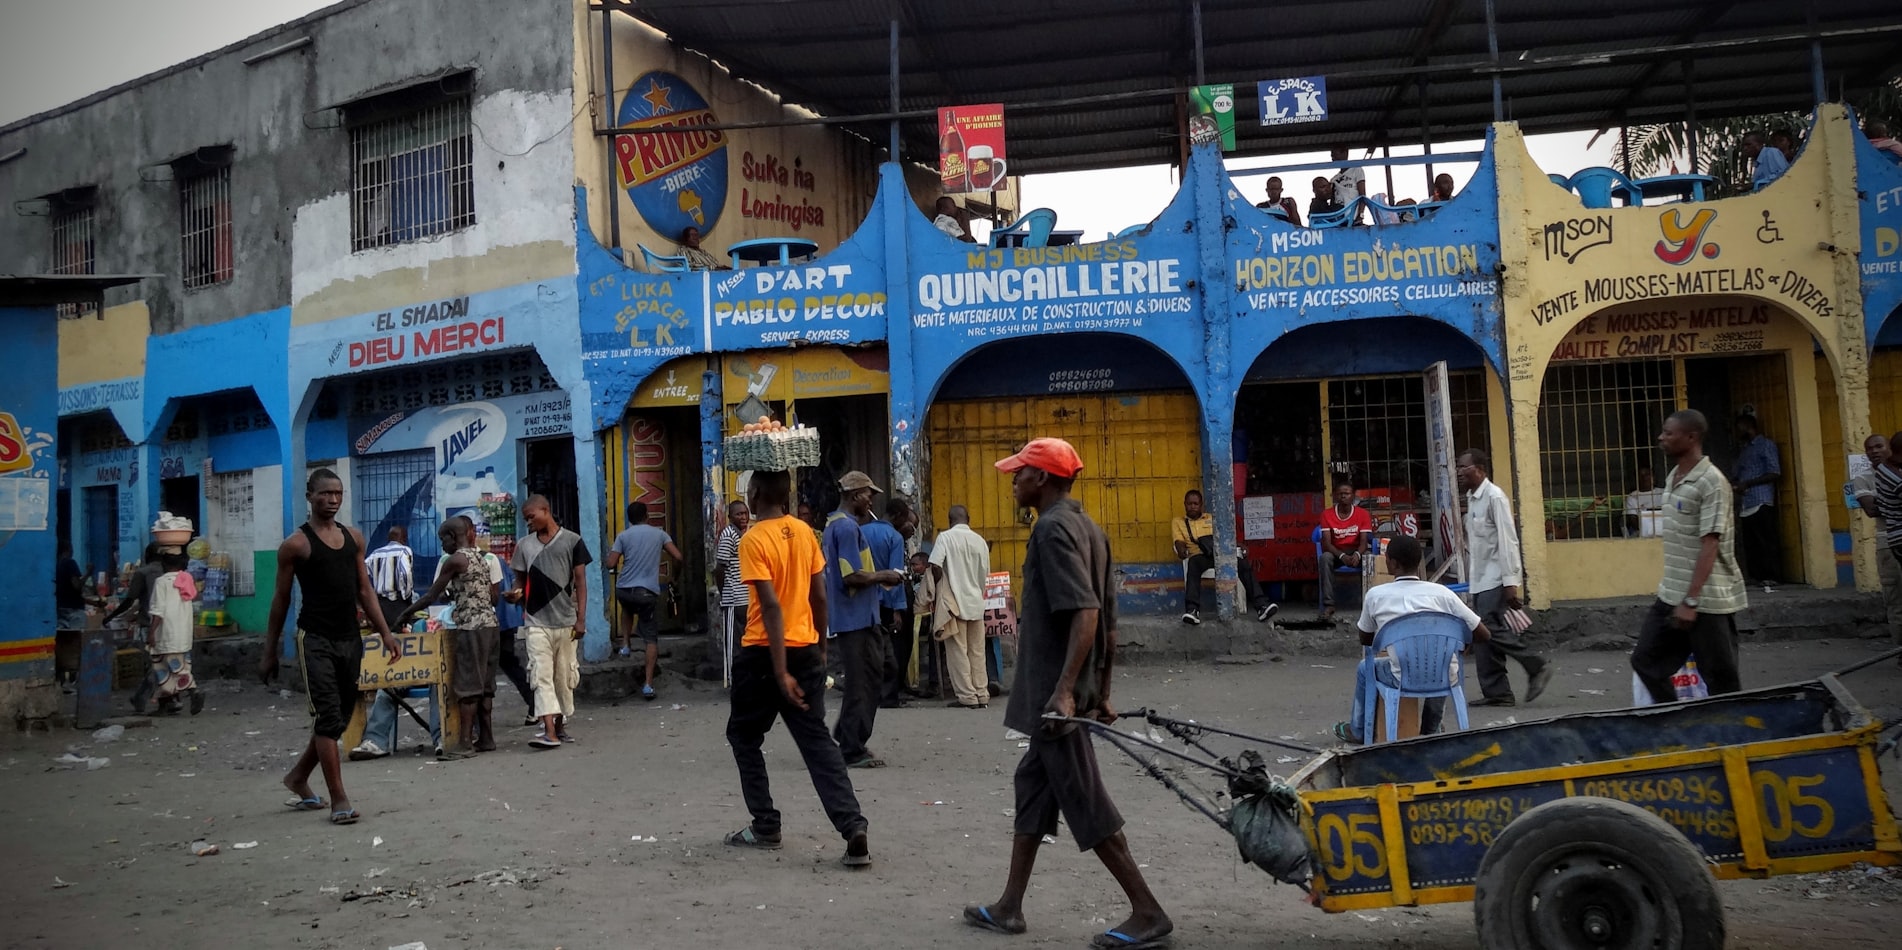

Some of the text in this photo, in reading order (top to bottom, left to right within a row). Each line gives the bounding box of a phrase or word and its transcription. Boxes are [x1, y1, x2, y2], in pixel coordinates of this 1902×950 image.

[1268, 78, 1315, 95] ESPACE
[965, 121, 1002, 130] D'HOMMES
[973, 114, 1002, 122] AFFAIRE
[615, 112, 723, 185] PRIMUS
[741, 187, 825, 231] Loningisa
[1014, 240, 1139, 267] BUSINESS
[1272, 230, 1324, 254] MSON
[756, 265, 852, 294] D'ART
[1236, 244, 1479, 291] HORIZON EDUCATION
[1861, 261, 1897, 275] VENTE
[621, 280, 674, 301] LUKA
[919, 258, 1182, 311] QUINCAILLERIE
[1248, 280, 1498, 310] VENTE ACCESSOIRES CELLULAIRES
[1531, 291, 1577, 327] VENTE
[1585, 267, 1765, 304] MOUSSES-MATELAS
[1779, 270, 1834, 319] DIVERS
[376, 296, 470, 332] EL SHADAI
[714, 292, 887, 327] PABLO DECOR
[913, 297, 1191, 328] VENTE MATERIEAUX DE CONSTRUCTION & DIVERS
[349, 334, 405, 368] DIEU
[413, 317, 504, 358] MERCI
[761, 329, 850, 343] SERVICE EXPRESS
[967, 327, 987, 336] NRC
[1552, 340, 1610, 360] UALITE
[653, 385, 689, 399] ENTREE
[439, 417, 488, 475] JAVEL
[984, 621, 1013, 636] artes
[385, 666, 431, 682] Cartes
[1752, 770, 1834, 842] 05
[1318, 813, 1387, 881] 05
